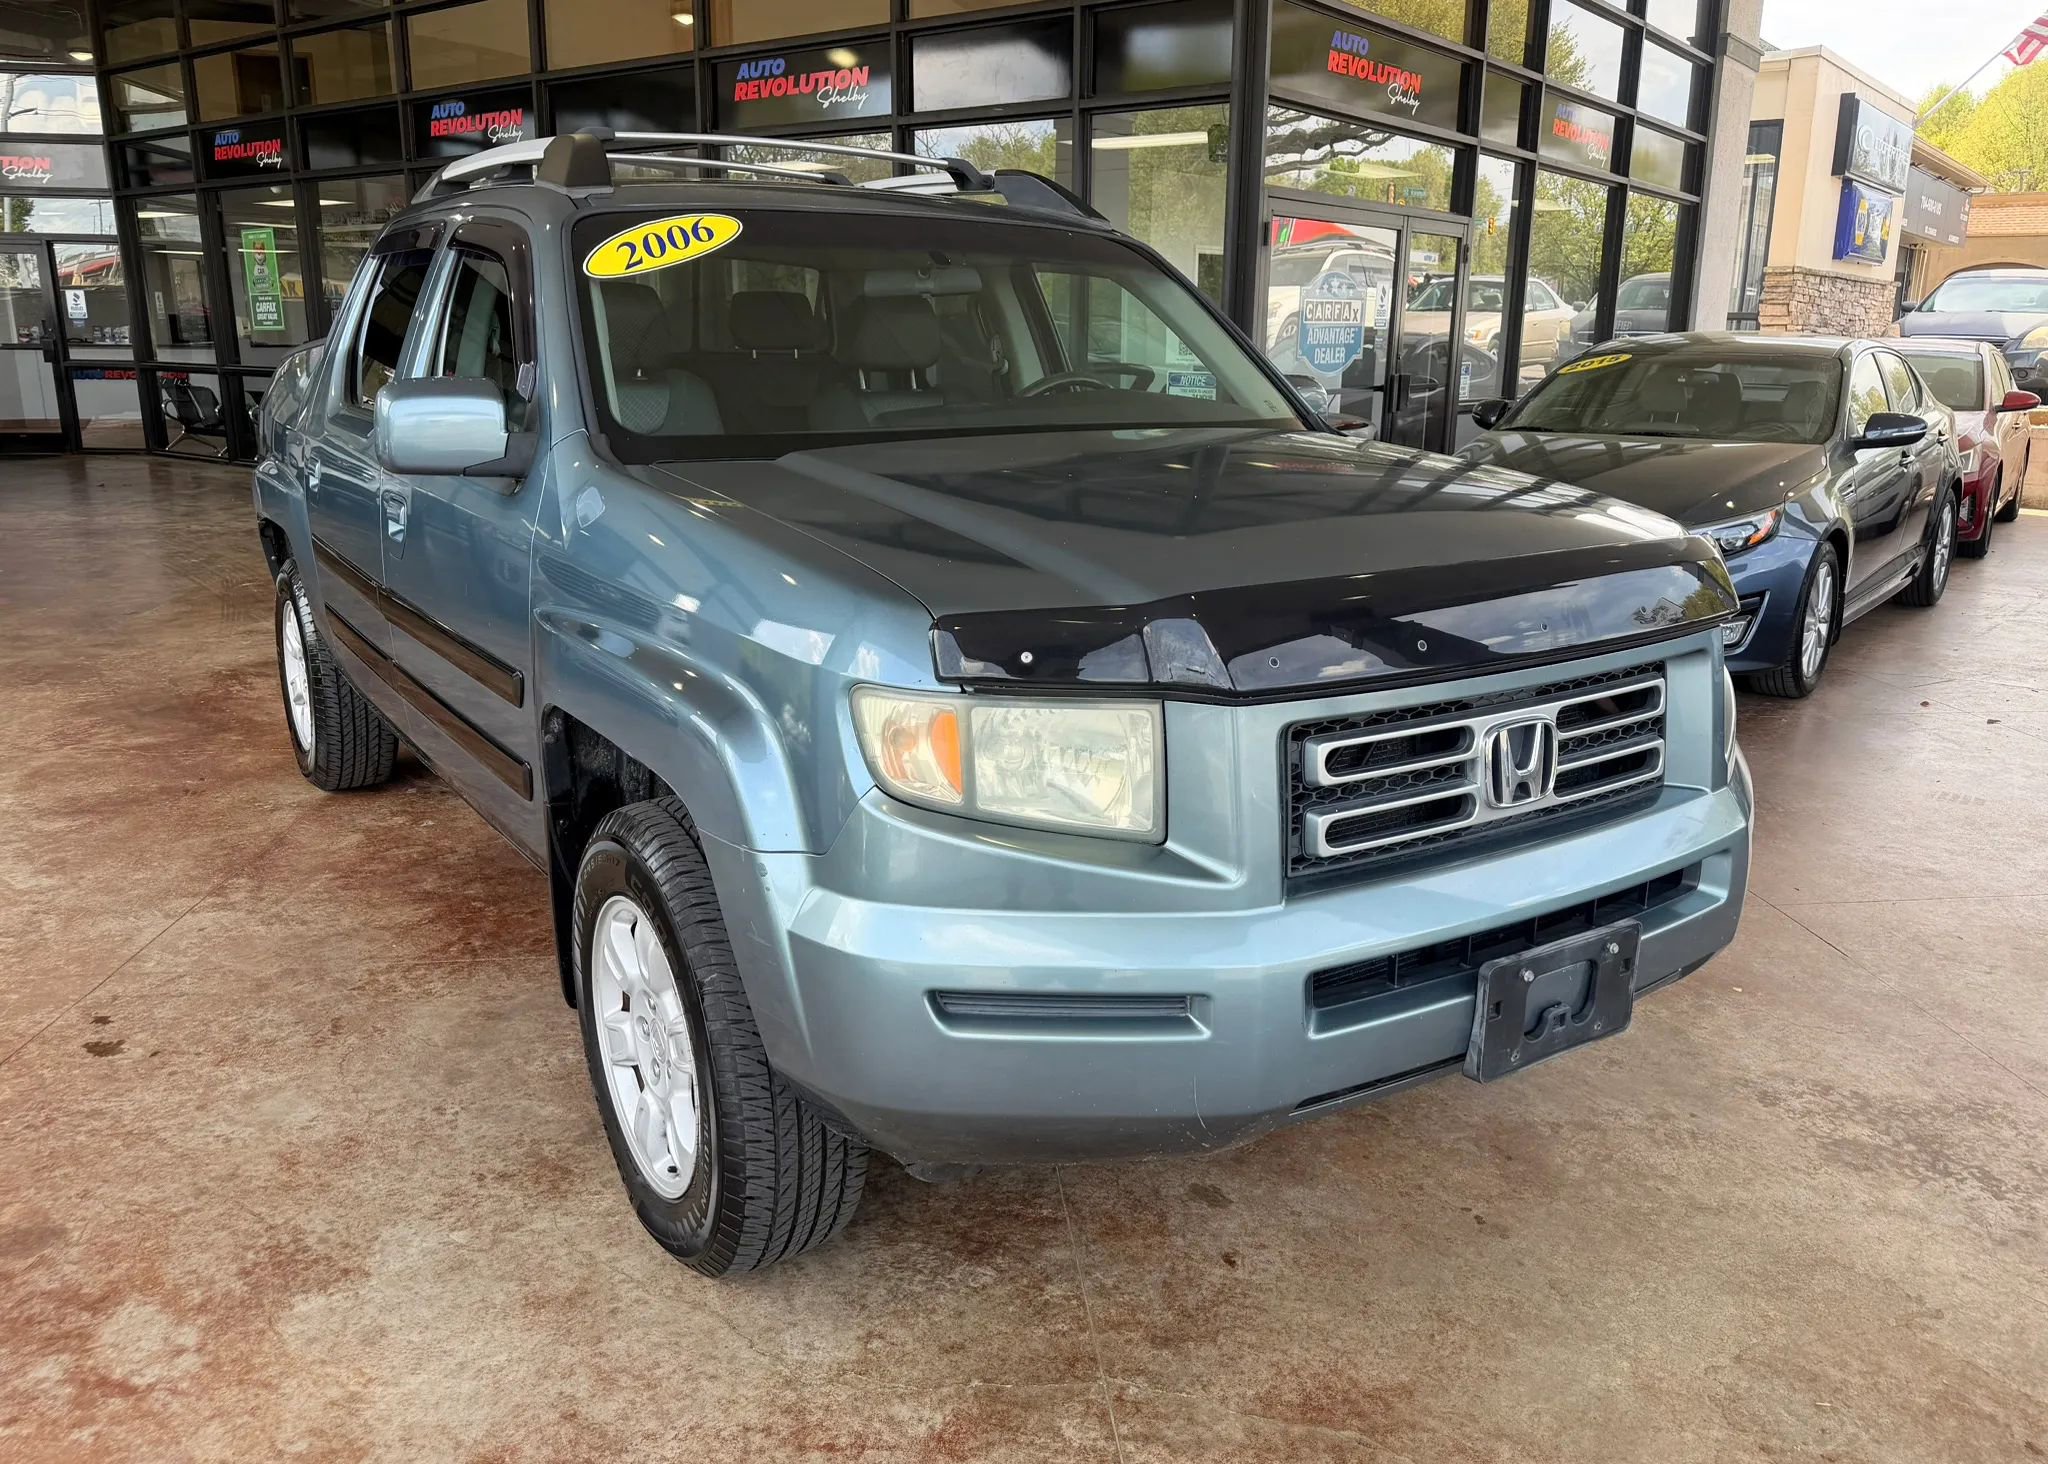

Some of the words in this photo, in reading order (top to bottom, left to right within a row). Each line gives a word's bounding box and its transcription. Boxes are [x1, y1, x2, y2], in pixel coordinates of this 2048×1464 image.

[1331, 31, 1369, 55] AUTO
[737, 58, 785, 80] AUTO
[1327, 49, 1423, 94] REVOLUTION
[734, 66, 870, 101] REVOLUTION
[816, 81, 869, 110] Shelby
[1387, 83, 1420, 116] Shelby
[431, 101, 465, 119] AUTO
[430, 108, 523, 137] REVOLUTION
[487, 121, 523, 143] Shelby
[214, 132, 240, 146] AUTO
[1552, 118, 1609, 151] REVOLUTION
[214, 138, 281, 160] REVOLUTION
[256, 148, 282, 169] Shelby
[2, 164, 53, 184] Shelby
[615, 216, 715, 271] 2006
[256, 302, 277, 312] CARFAX
[1304, 301, 1360, 322] CARFAX
[1307, 327, 1356, 345] ADVANTAGE
[1314, 347, 1345, 364] DEALER
[1180, 375, 1207, 386] NOTICE
